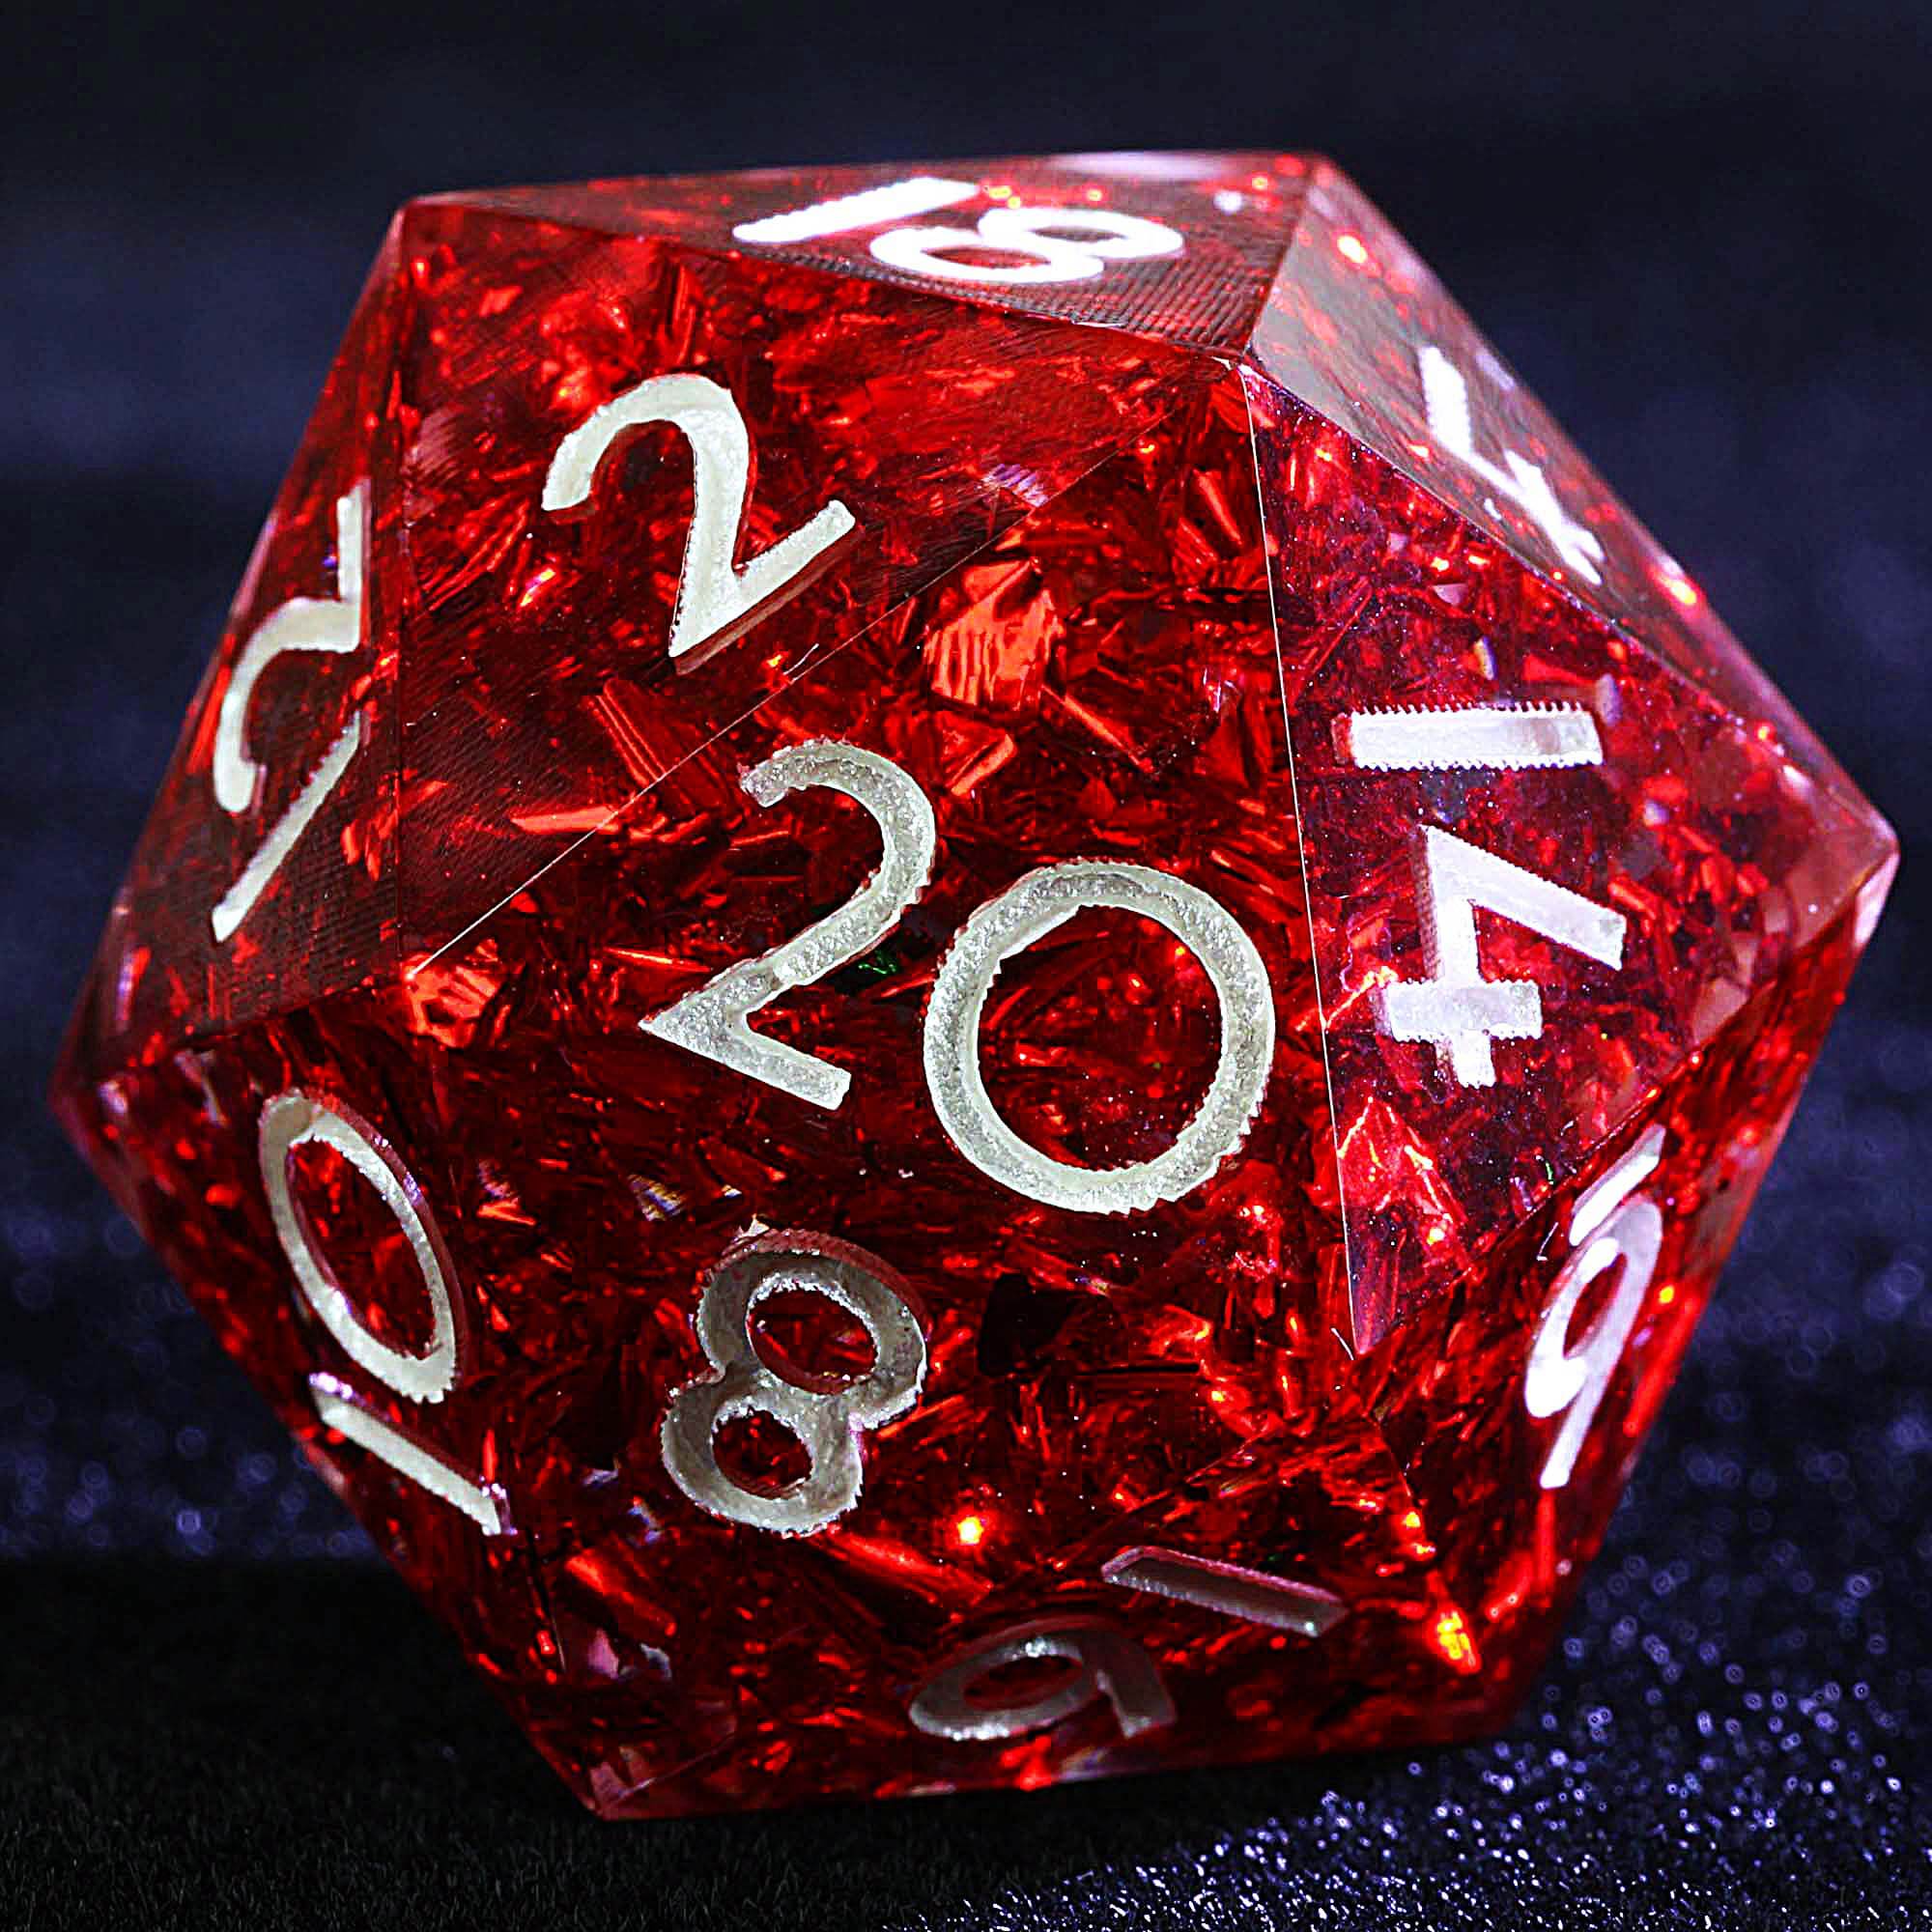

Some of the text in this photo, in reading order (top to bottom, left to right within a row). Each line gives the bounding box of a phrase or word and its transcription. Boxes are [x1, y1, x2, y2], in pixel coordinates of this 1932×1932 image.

[732, 176, 1185, 284] 18
[542, 373, 856, 659] 2
[1418, 345, 1606, 585] 4
[211, 478, 372, 944] 12
[638, 735, 1277, 1215] 20
[1346, 701, 1628, 1088] 14
[258, 1087, 514, 1537] 10
[661, 1227, 928, 1538] 8
[908, 1544, 1350, 1740] 16
